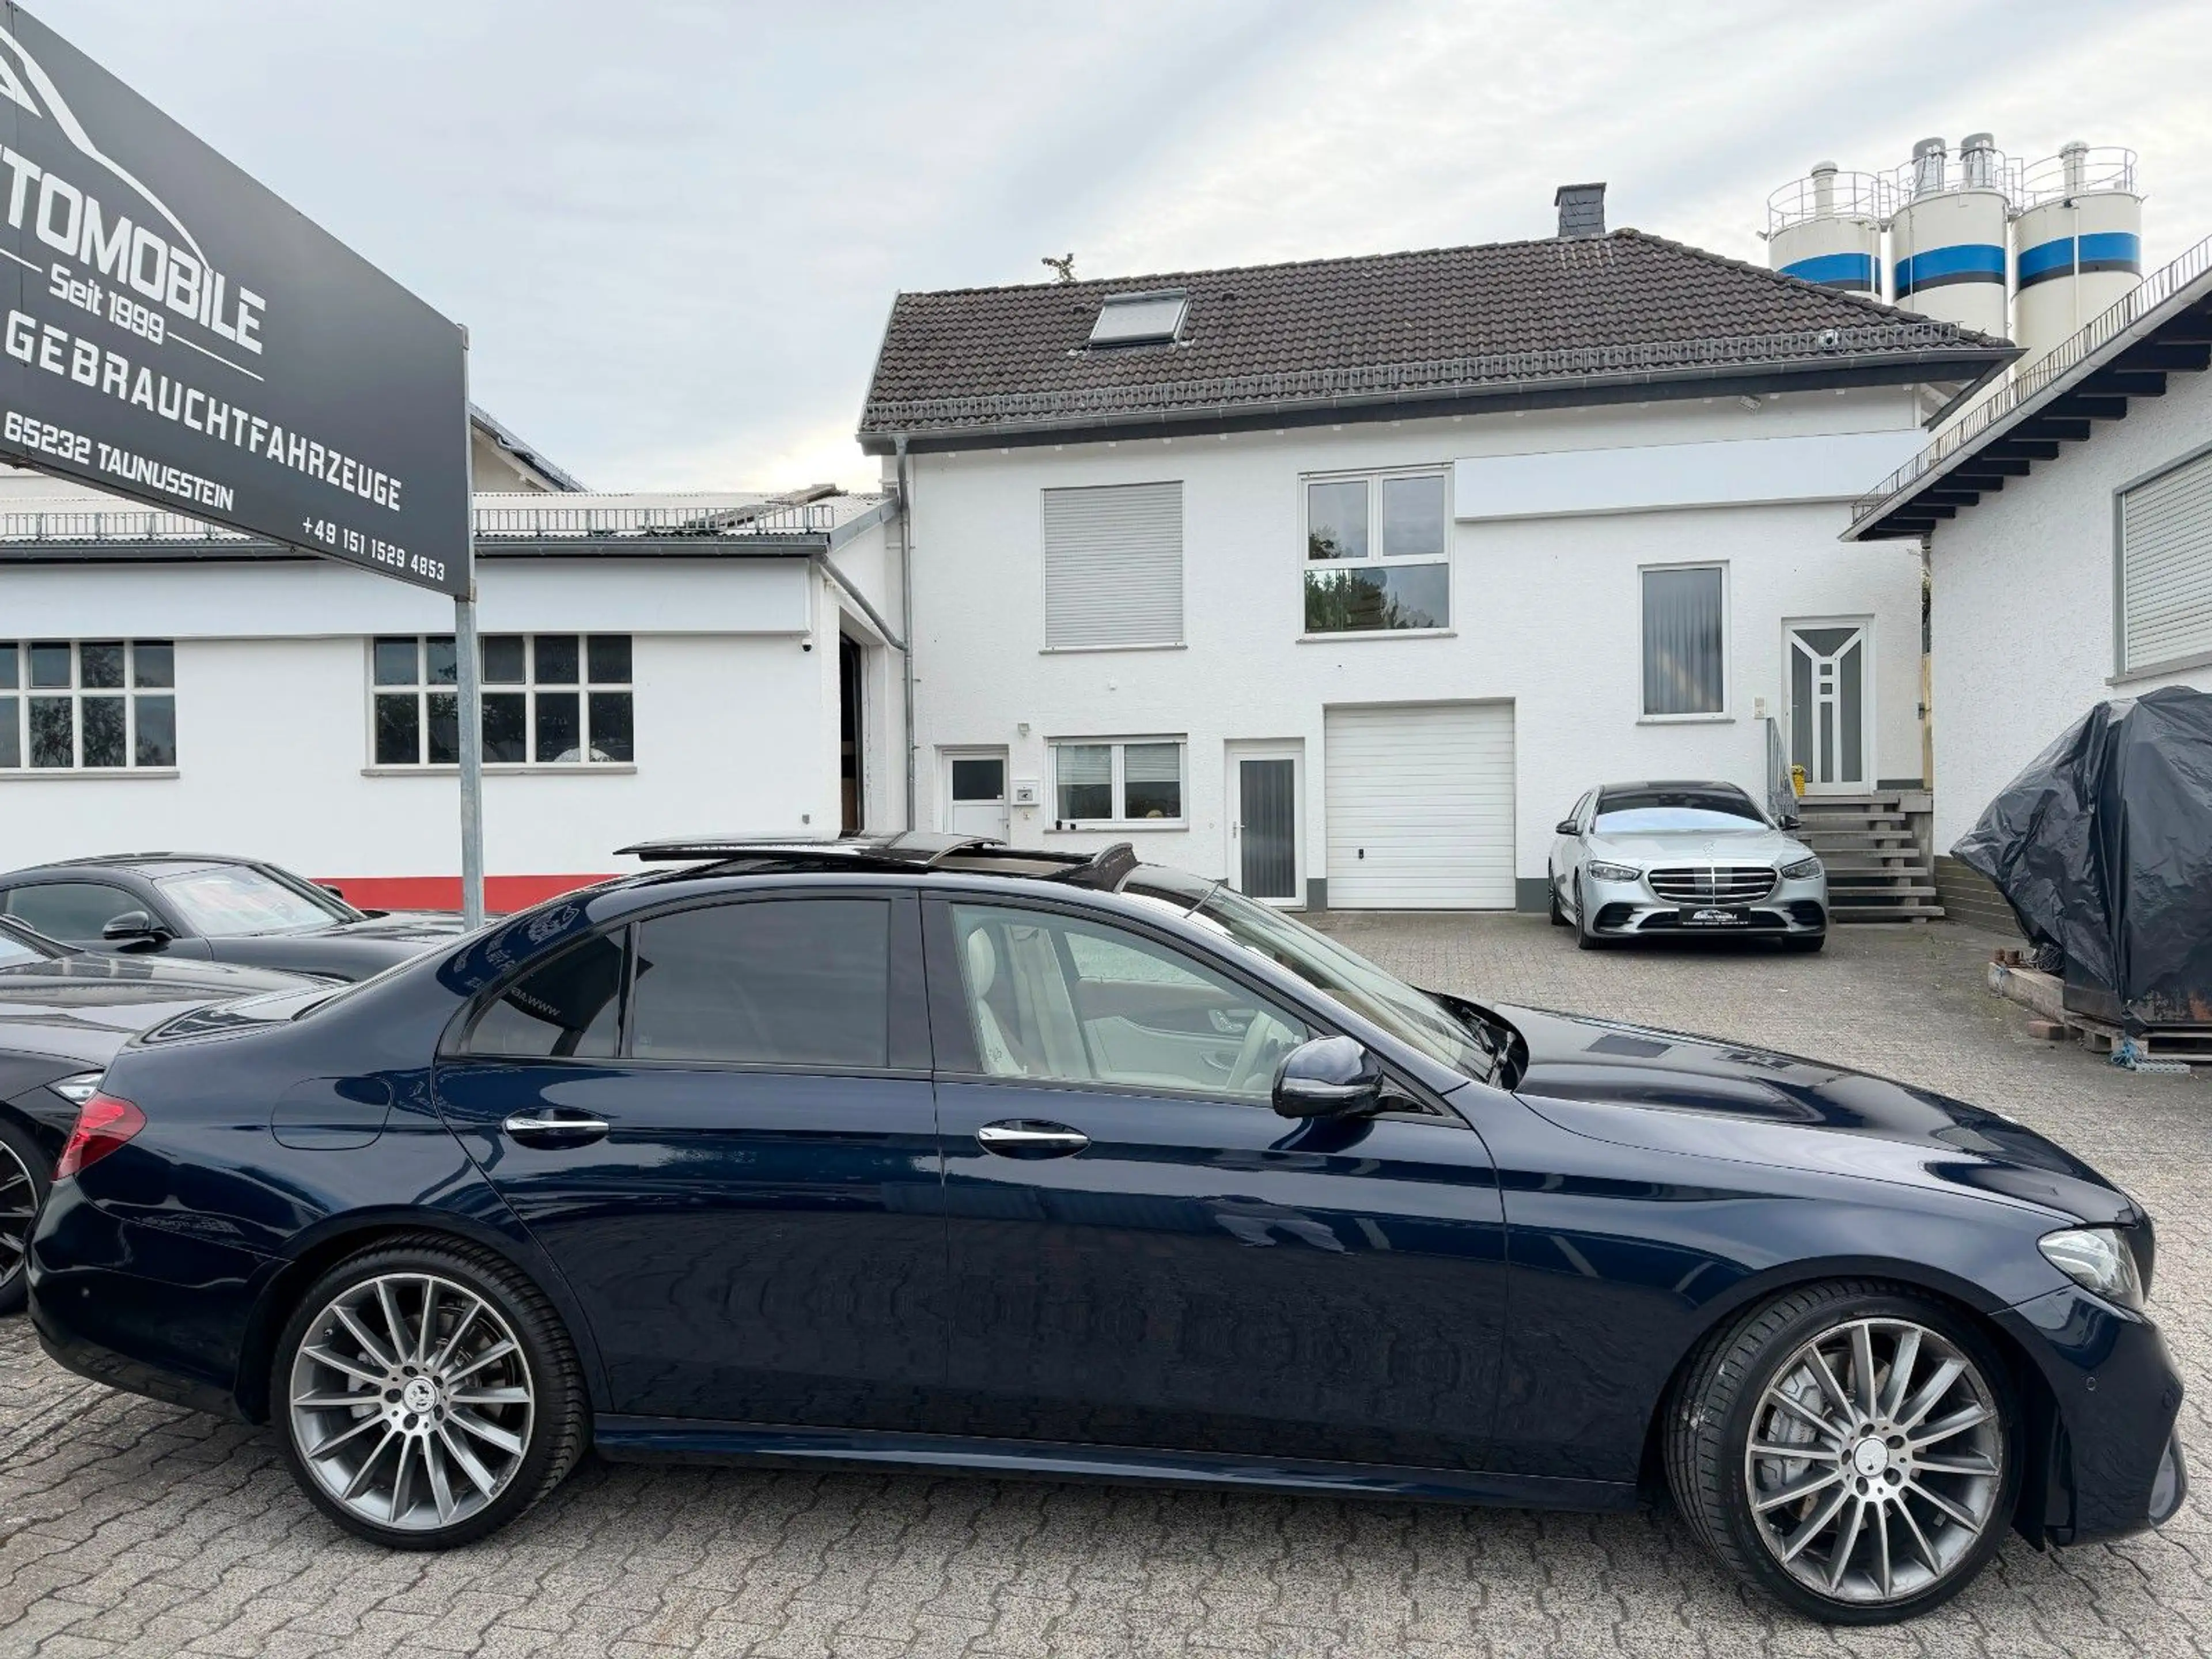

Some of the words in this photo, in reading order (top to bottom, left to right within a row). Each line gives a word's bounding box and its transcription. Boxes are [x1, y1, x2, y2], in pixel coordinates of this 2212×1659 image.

[0, 144, 266, 355] TOMOBILE
[50, 263, 103, 316] Seit
[108, 290, 165, 345] 1999
[5, 309, 402, 512] GEBRAUCHTFAHRZEUGE
[4, 411, 92, 465] 65232
[97, 441, 234, 512] TAUNUSSTEIN
[302, 517, 336, 544] +49
[343, 528, 365, 555] 151
[372, 539, 404, 568] 1529
[410, 554, 445, 582] 4853
